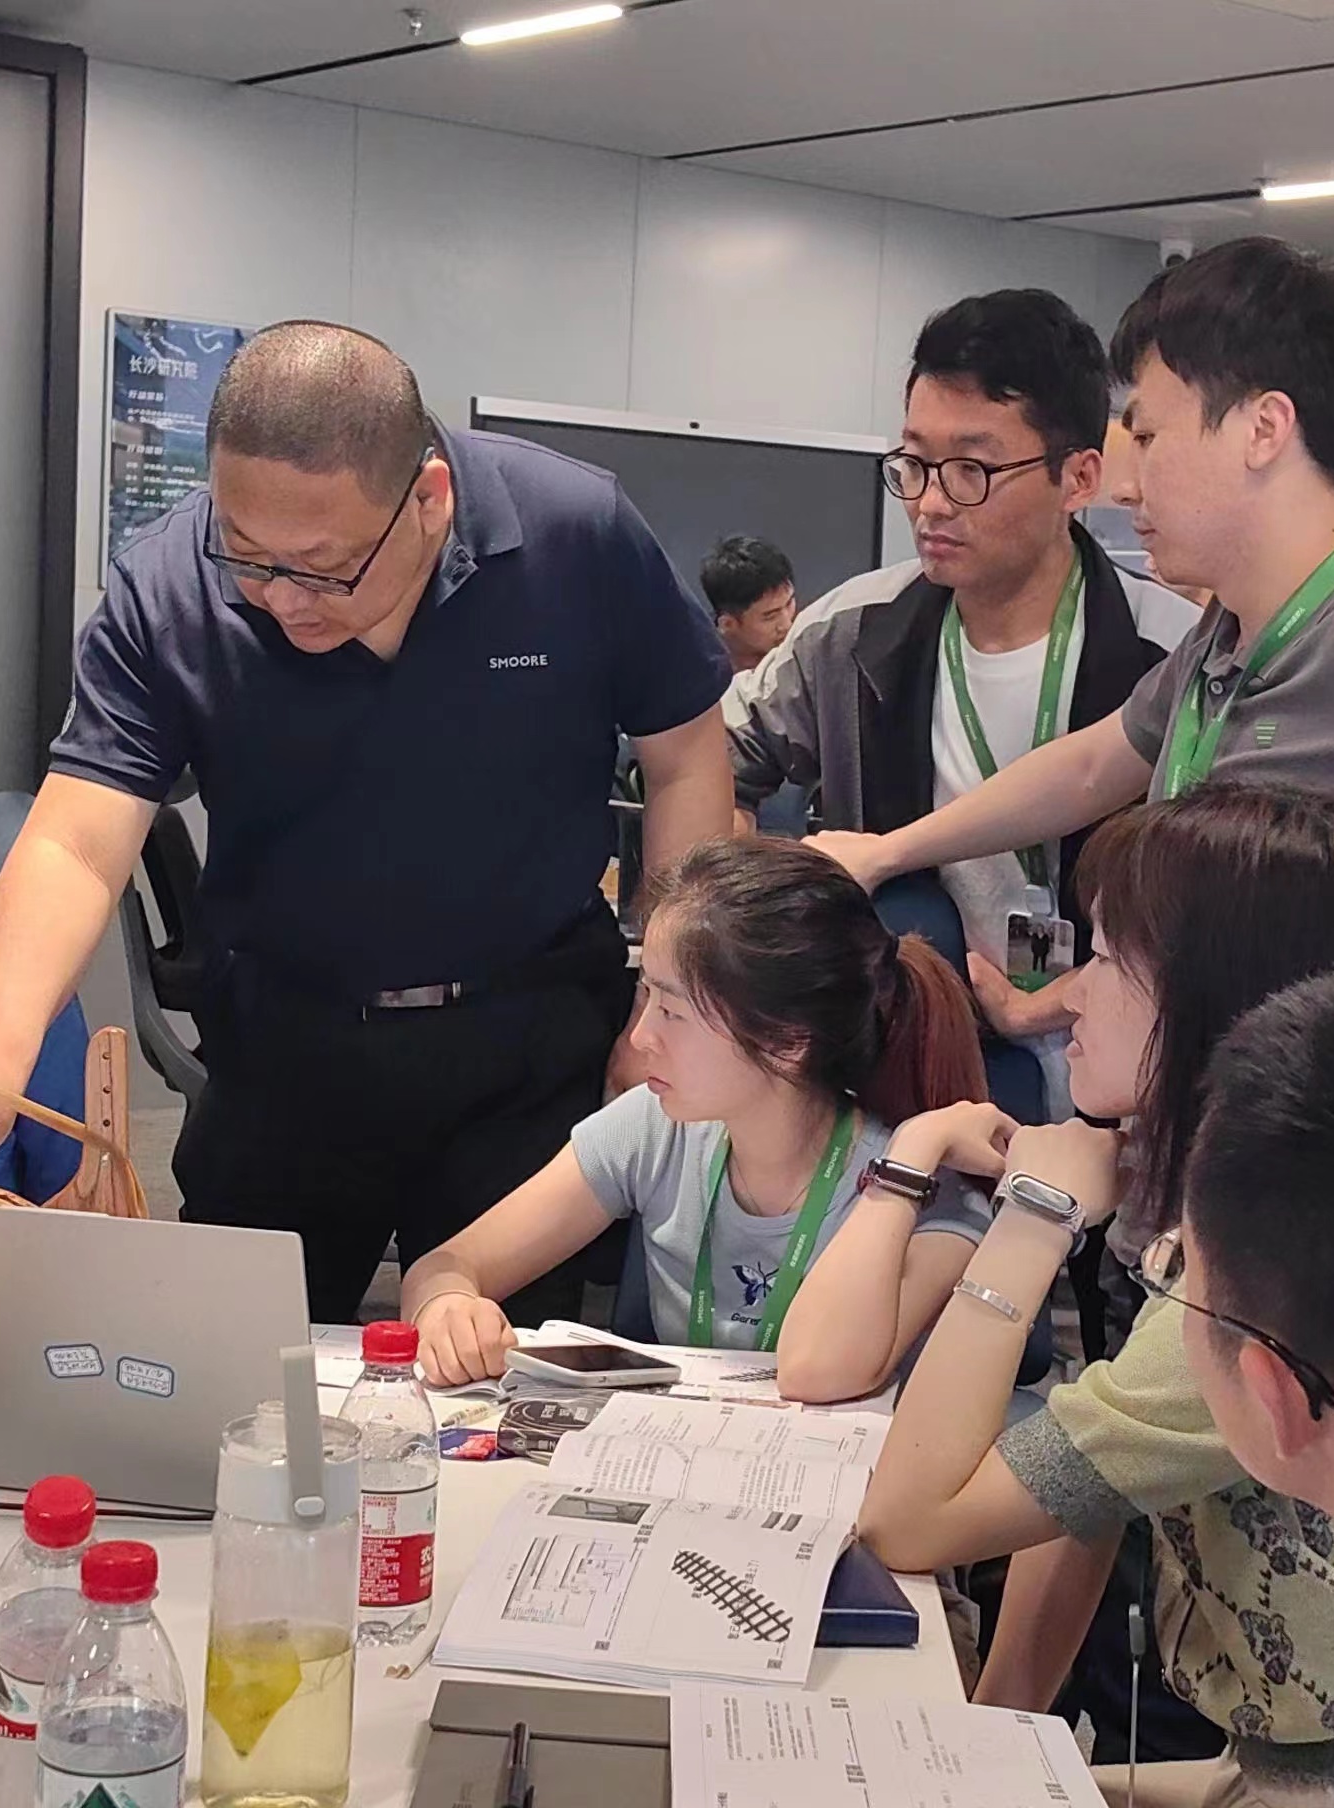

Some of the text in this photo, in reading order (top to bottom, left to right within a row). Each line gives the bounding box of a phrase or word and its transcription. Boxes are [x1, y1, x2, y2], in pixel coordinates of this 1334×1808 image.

[129, 354, 198, 380] 长沙研究院
[489, 654, 548, 669] SMOORE
